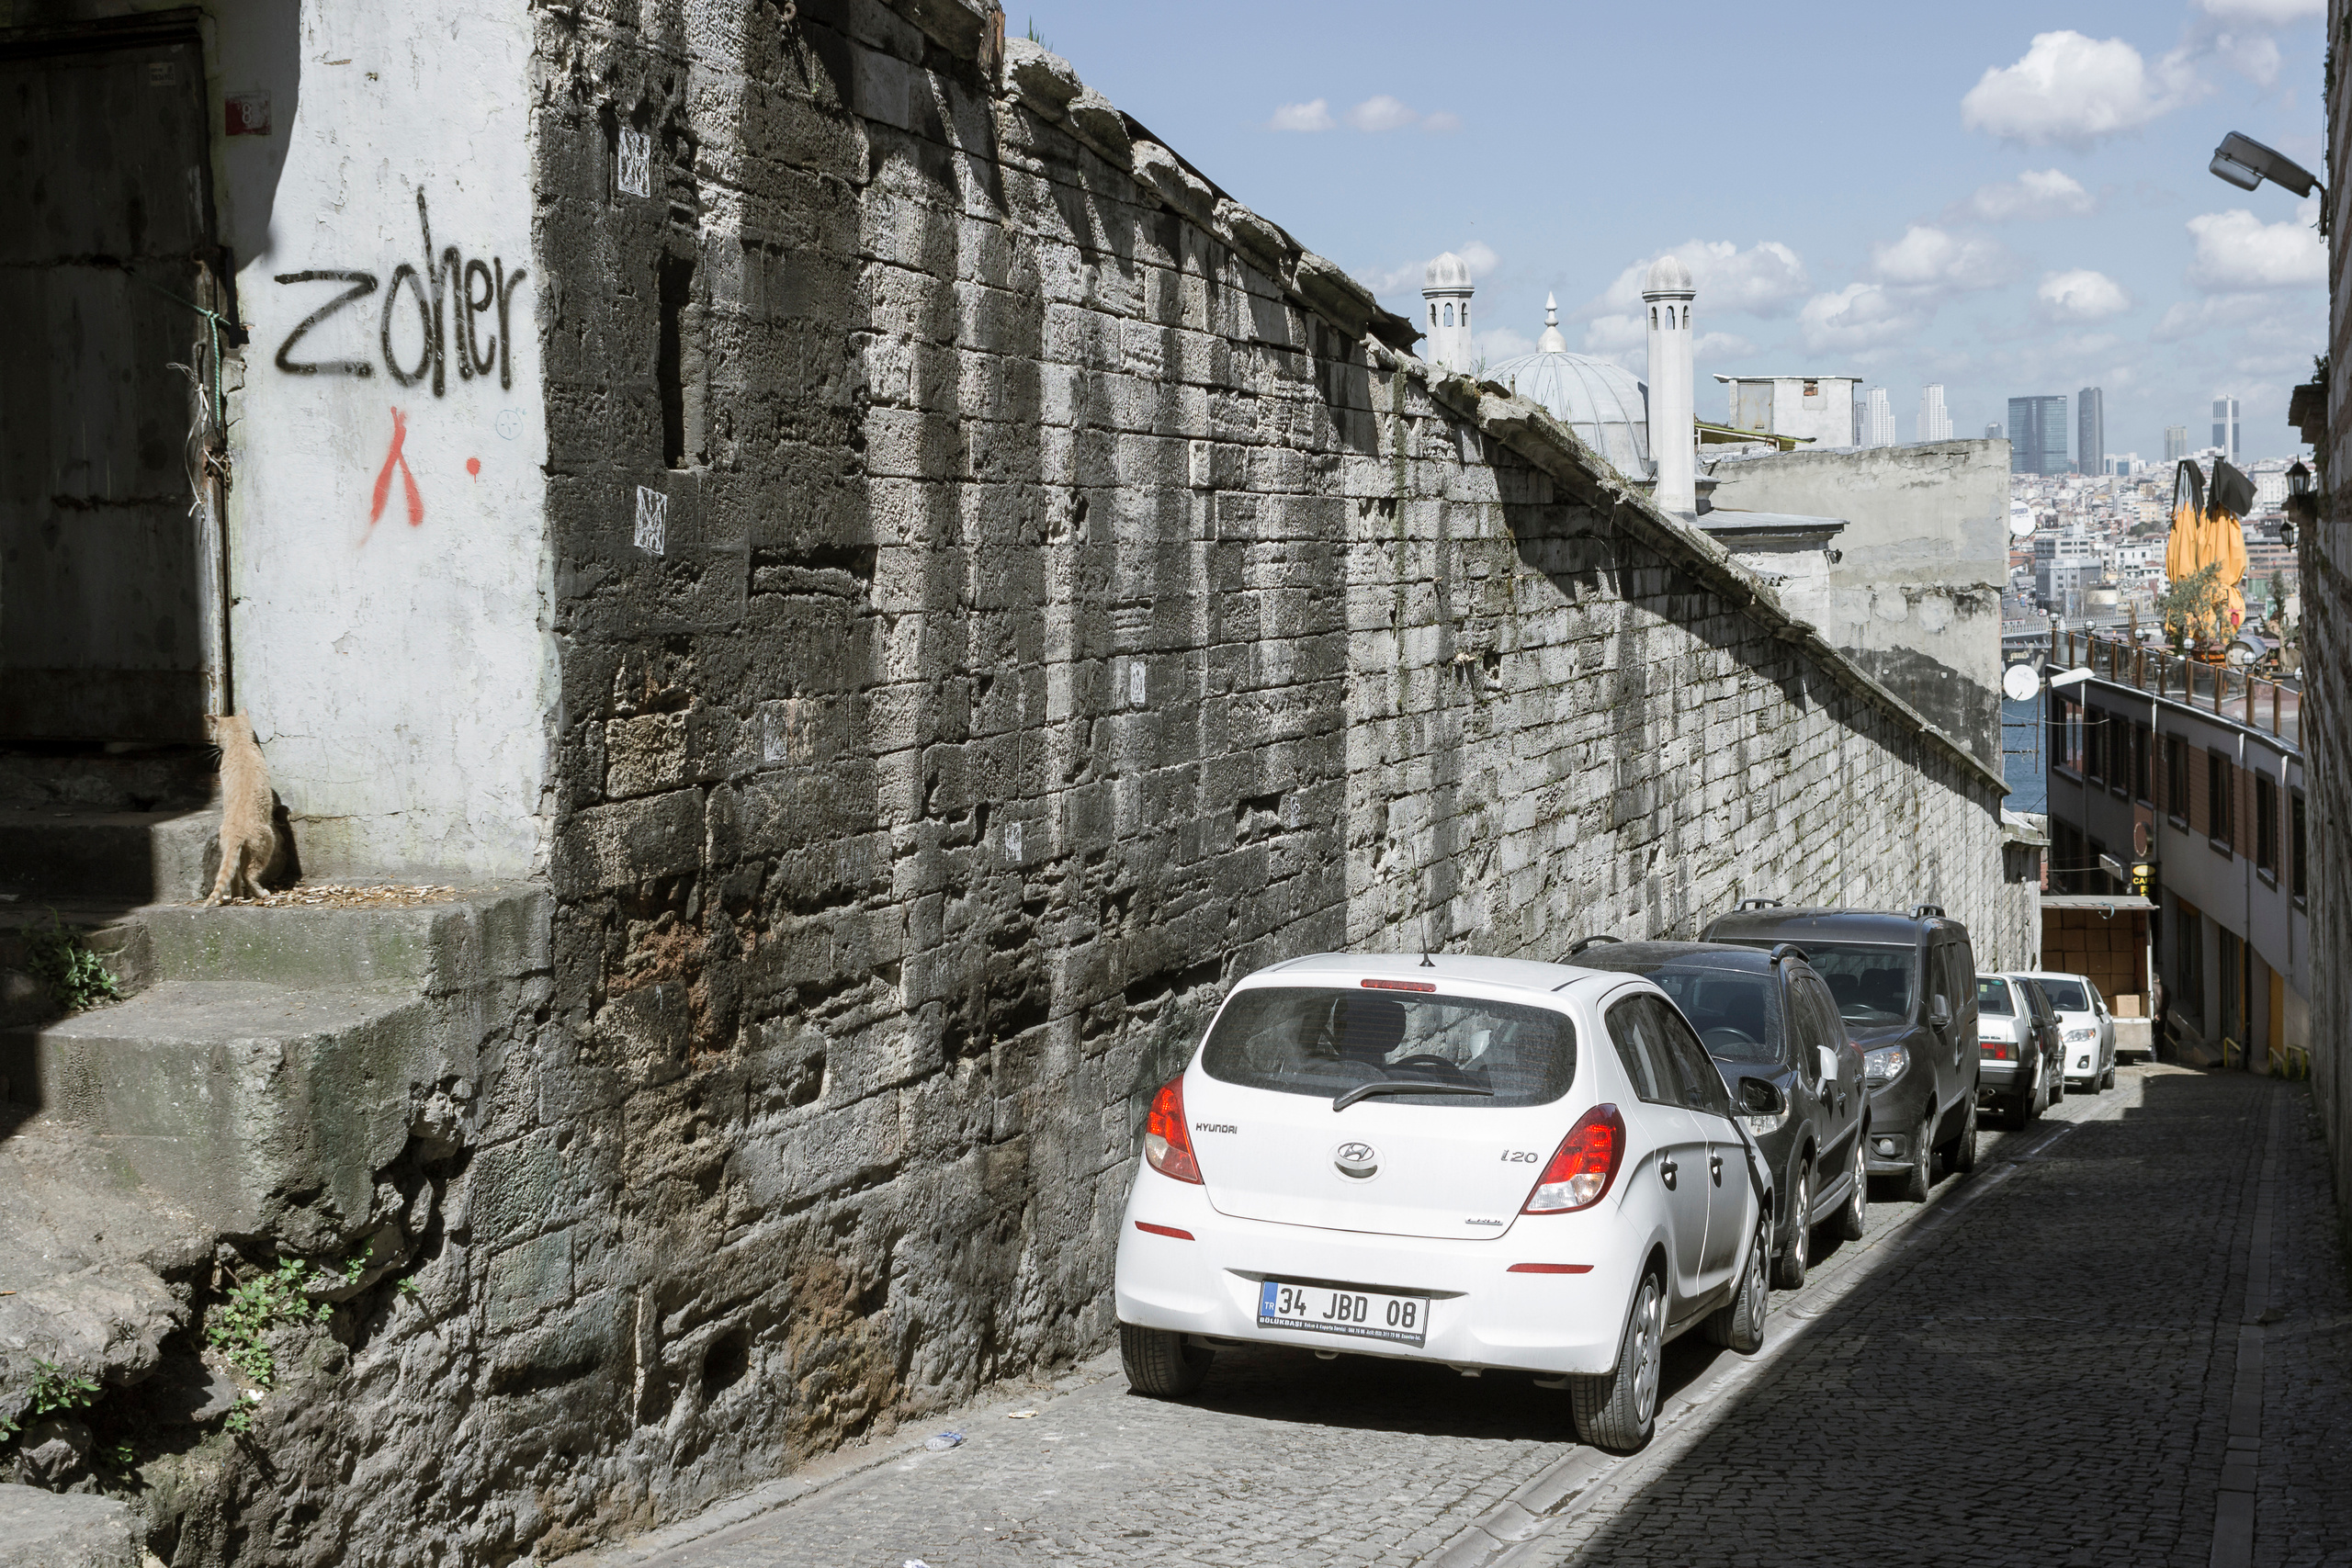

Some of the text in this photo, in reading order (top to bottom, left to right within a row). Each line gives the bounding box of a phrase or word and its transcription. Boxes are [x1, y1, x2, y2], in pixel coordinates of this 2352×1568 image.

[242, 103, 252, 124] 8
[1195, 1122, 1238, 1134] HYUNDAI
[1264, 1302, 1275, 1311] TR
[1278, 1288, 1417, 1328] 34 JBD 08
